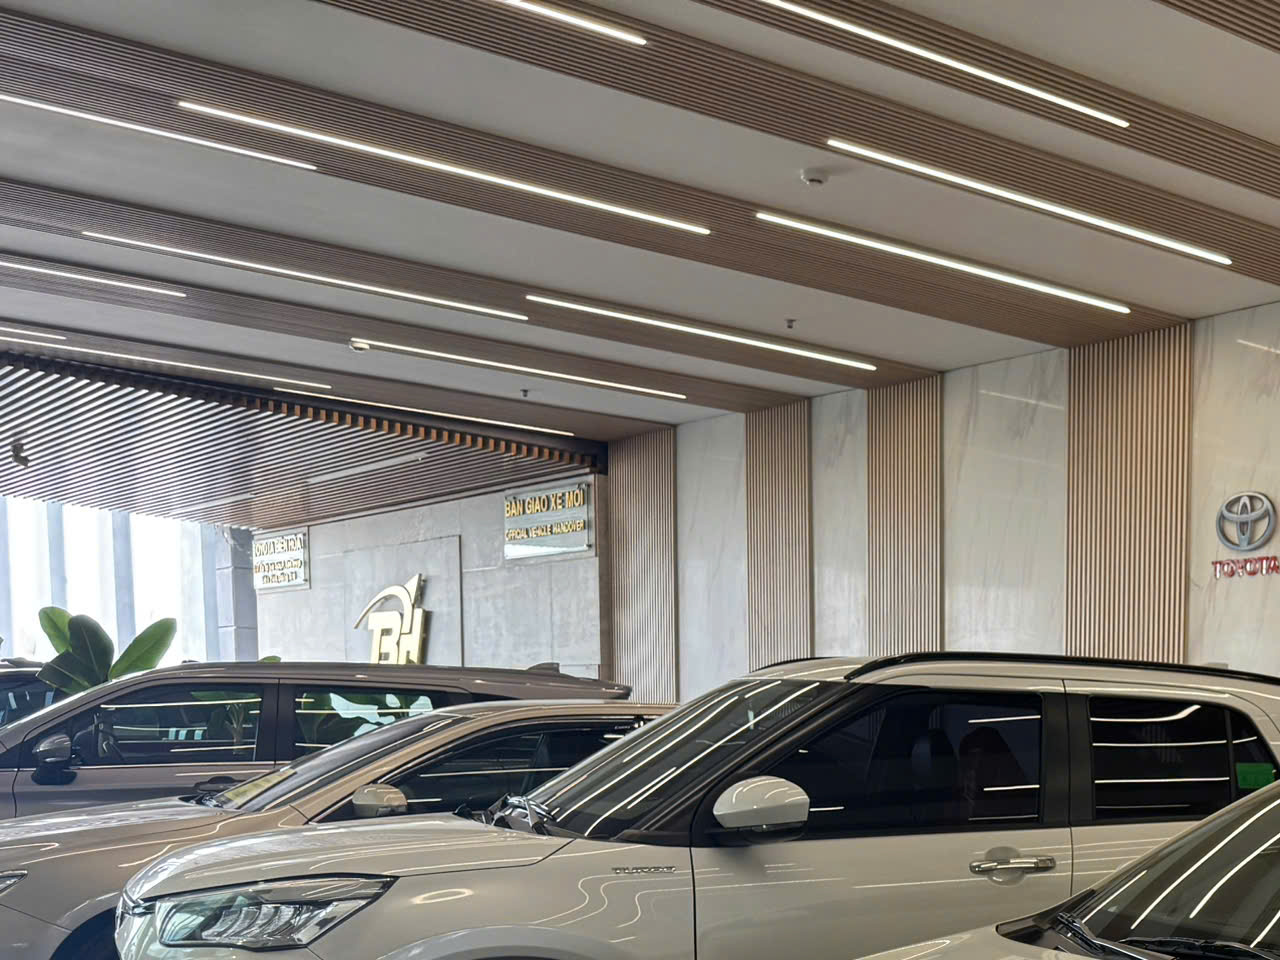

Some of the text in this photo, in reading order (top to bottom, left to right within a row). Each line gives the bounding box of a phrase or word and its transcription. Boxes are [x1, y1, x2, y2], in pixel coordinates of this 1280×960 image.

[525, 495, 550, 515] GIAO
[550, 492, 564, 511] XE
[1212, 556, 1280, 579] TOYOTA
